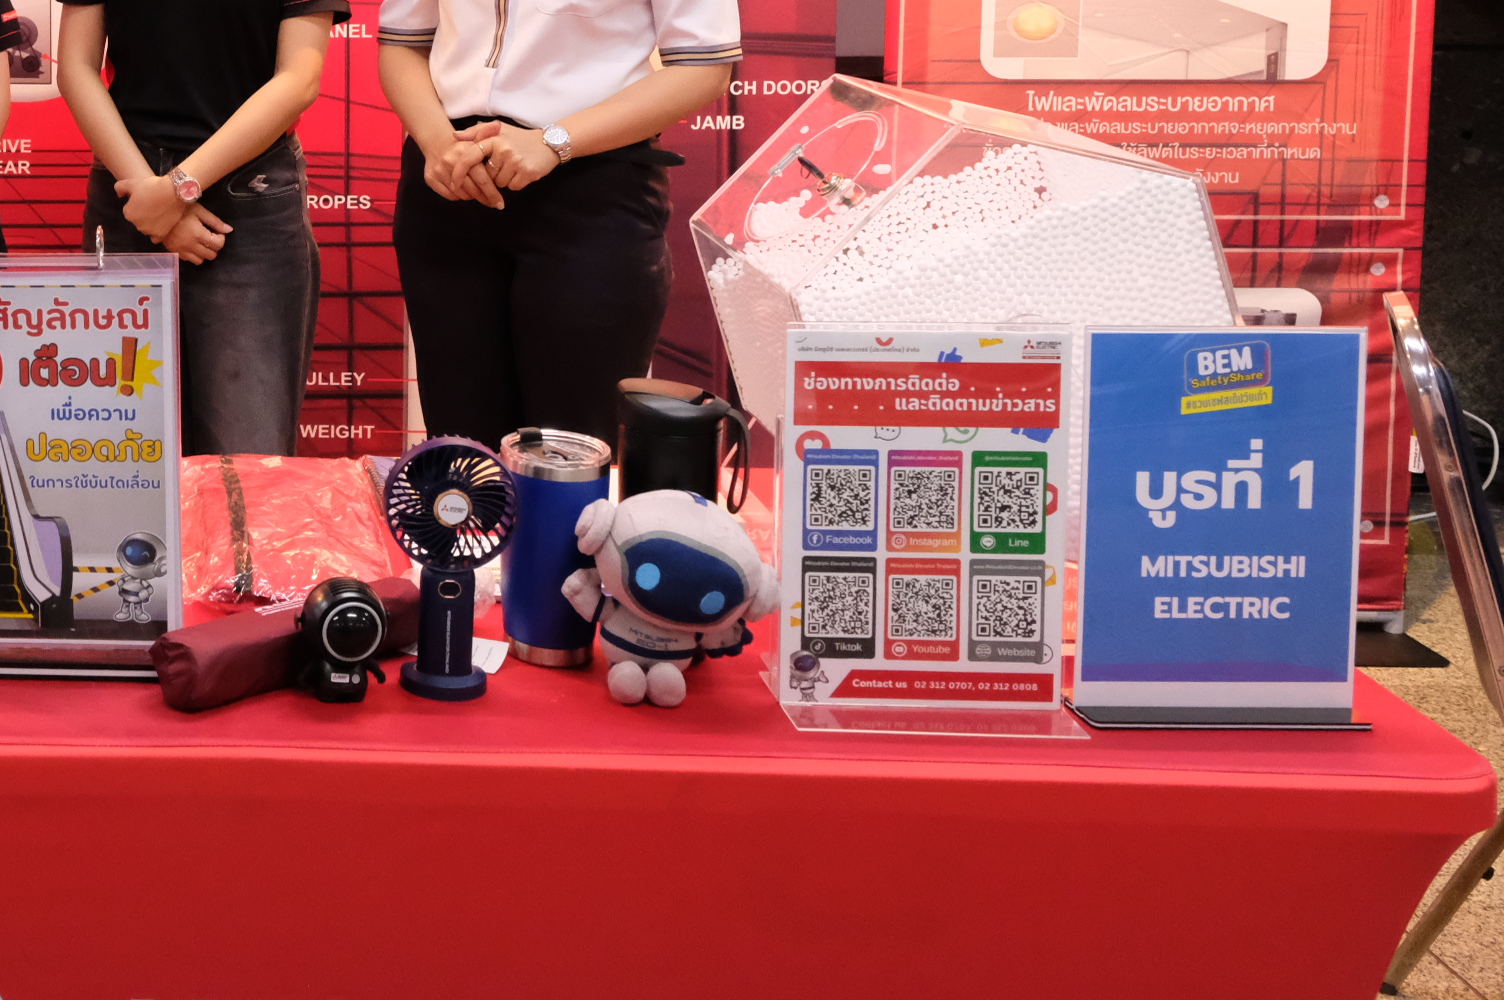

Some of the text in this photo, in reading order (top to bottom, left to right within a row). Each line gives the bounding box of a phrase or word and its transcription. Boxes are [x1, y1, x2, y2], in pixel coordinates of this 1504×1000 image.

[763, 80, 828, 95] DOOR
[1026, 90, 1275, 112] ไฟและพัดลมระบายอากาศ
[691, 115, 745, 130] JAMB
[306, 193, 371, 210] ROPES
[1197, 346, 1253, 376] BEM
[306, 372, 365, 386] ULLEY
[803, 371, 960, 391] ช่องทางการติดต่อ
[1191, 372, 1264, 388] SafetyShare
[51, 395, 136, 421] เพื่อความ
[895, 393, 1056, 412] และติดตามข่าวสาร
[300, 425, 375, 439] WEIGHT
[26, 428, 162, 462] ปลอดภัย
[29, 470, 161, 490] ในการใช้บันไดเลื่อน
[1289, 460, 1314, 509] 1
[826, 534, 872, 545] Facebook
[909, 537, 957, 547] Instagram
[1008, 538, 1029, 547] Line
[1140, 554, 1306, 578] MITSUBISHI
[1154, 596, 1291, 620] ELECTRIC
[834, 642, 862, 652] Tiktok
[912, 644, 950, 654] Youtube
[997, 647, 1036, 657] Website
[852, 678, 1038, 691] Contact us 02 312 0707, 02 312 0808
